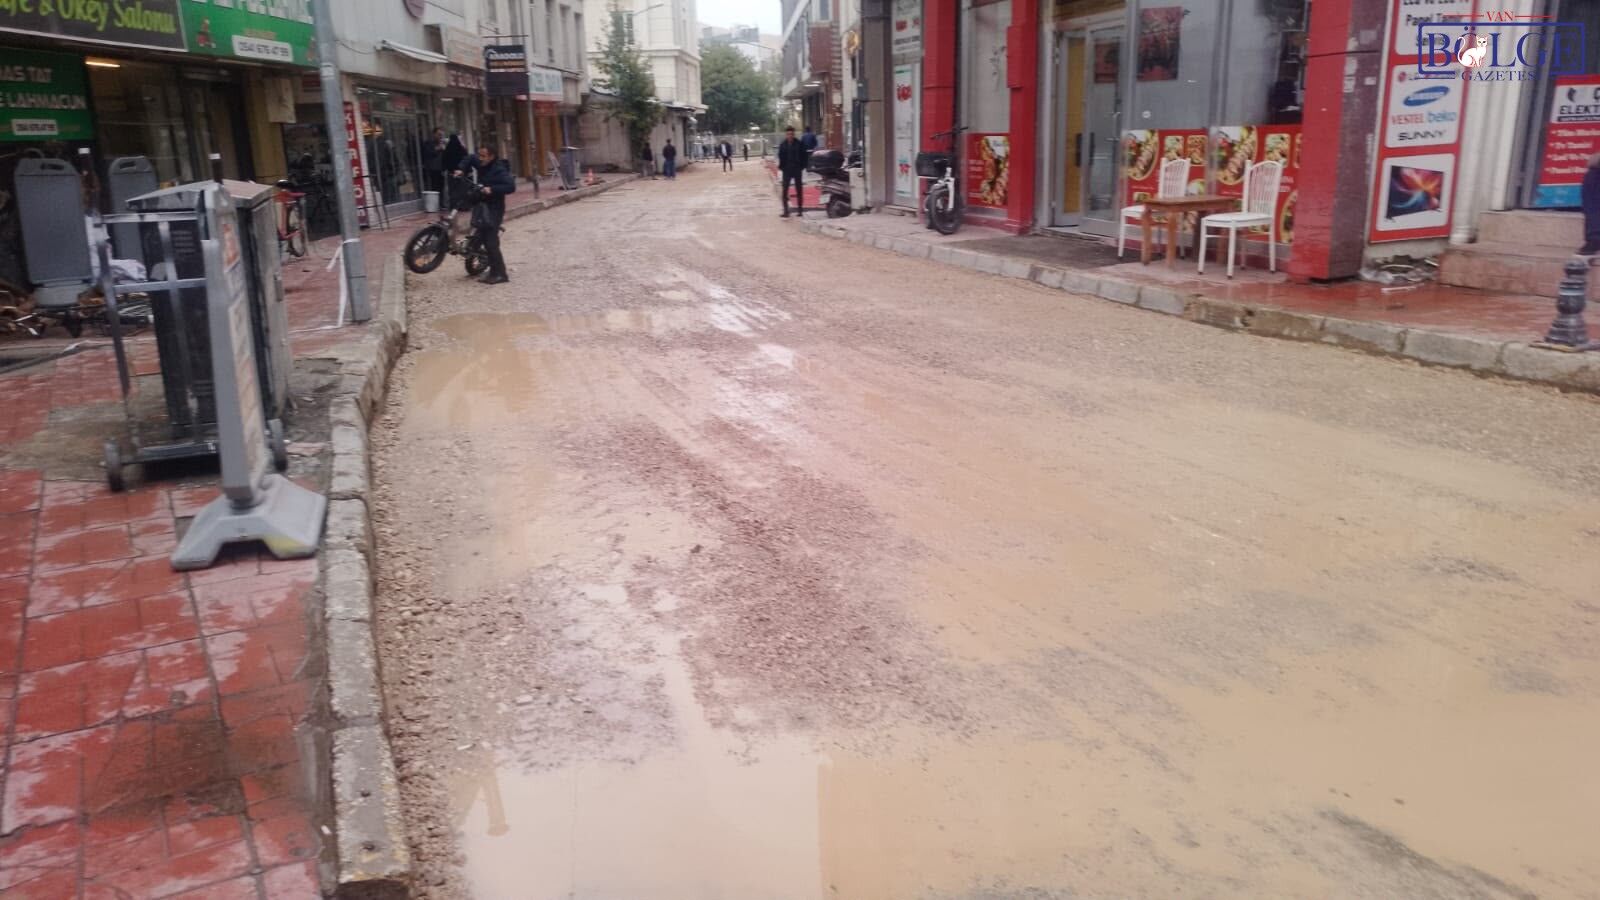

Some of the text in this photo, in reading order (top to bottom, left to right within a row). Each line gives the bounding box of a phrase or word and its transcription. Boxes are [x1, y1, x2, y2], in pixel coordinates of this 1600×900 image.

[1392, 111, 1457, 125] VESTEL beko
[1398, 130, 1445, 141] SUNNY
